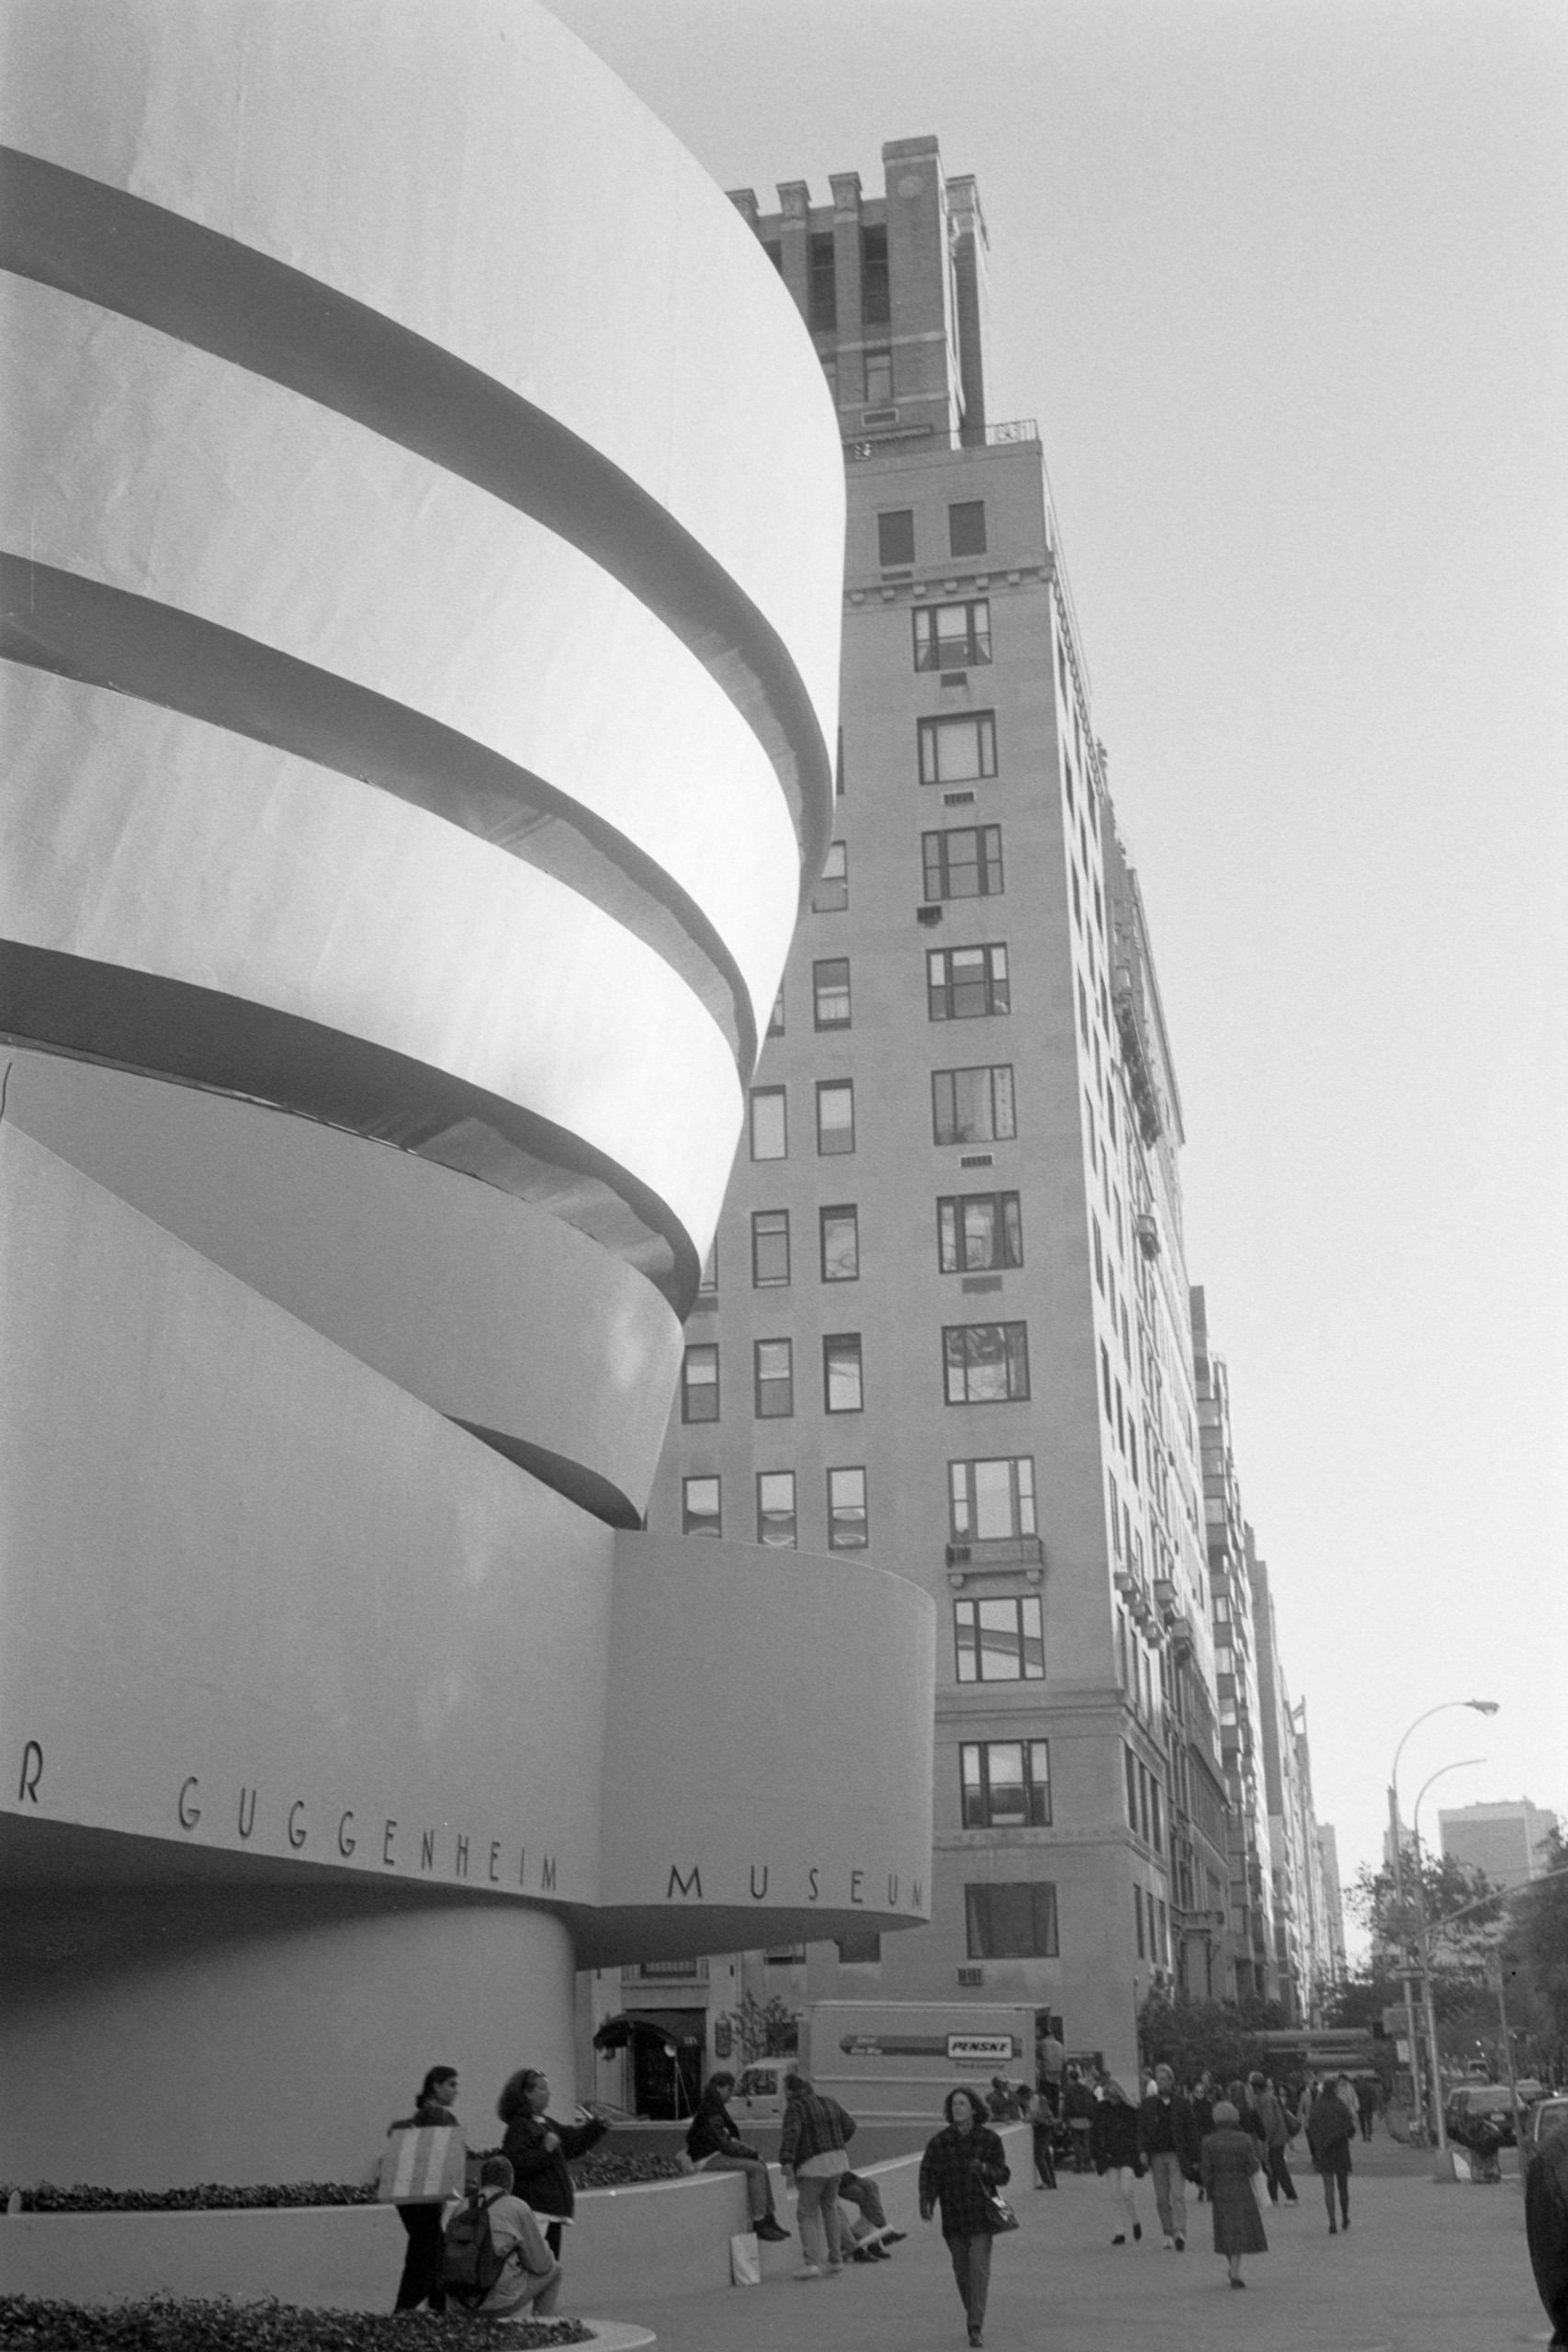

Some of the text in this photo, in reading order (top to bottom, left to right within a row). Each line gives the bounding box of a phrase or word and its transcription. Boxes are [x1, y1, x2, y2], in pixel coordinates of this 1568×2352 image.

[18, 1739, 922, 1911] R GUGGENHEIM MUSEUM
[952, 2041, 1010, 2052] PENSKE
